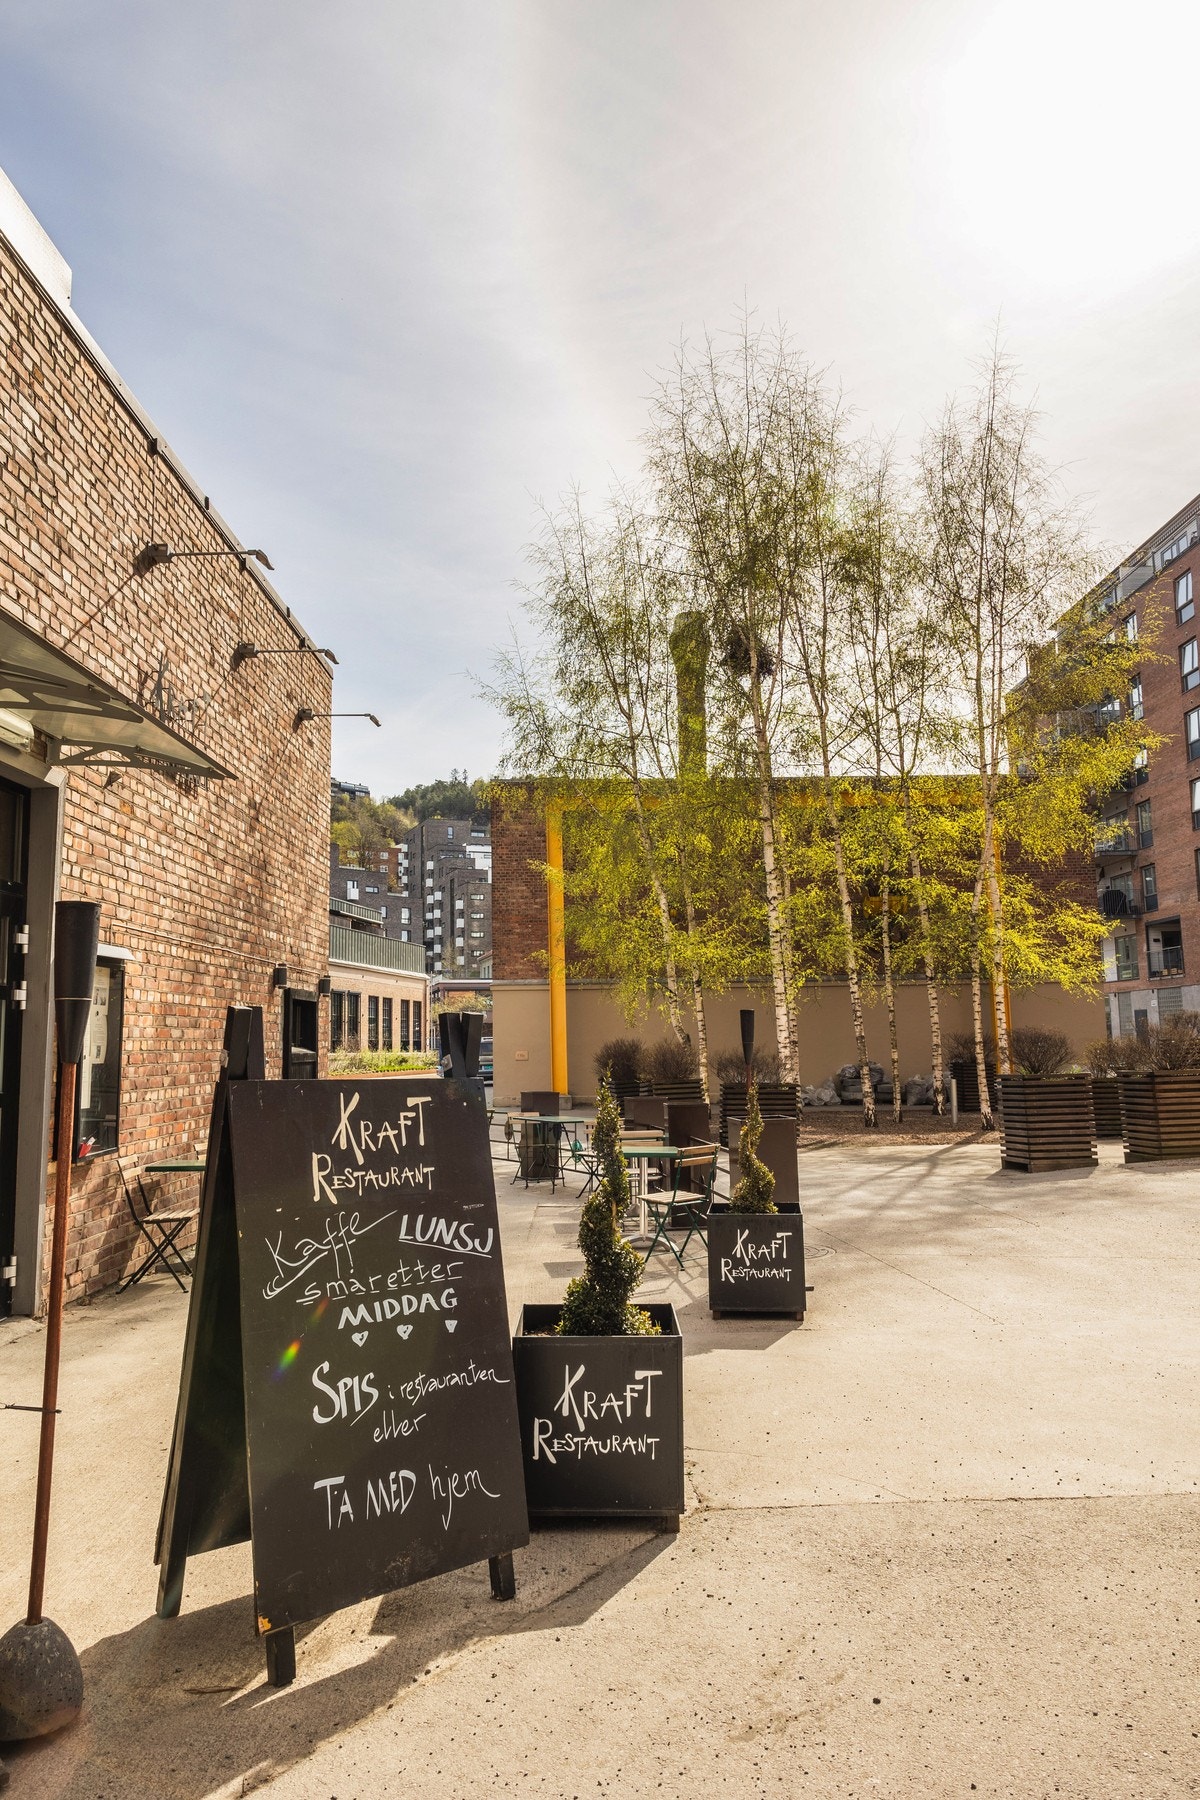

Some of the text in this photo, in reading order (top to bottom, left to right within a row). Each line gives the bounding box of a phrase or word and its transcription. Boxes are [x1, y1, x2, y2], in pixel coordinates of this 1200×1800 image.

[331, 1091, 432, 1165] KRAFT
[311, 1152, 435, 1204] RESTAURANT
[264, 1209, 494, 1279] Kaffe LUNSJ
[731, 1228, 793, 1266] KRAFT
[720, 1257, 793, 1284] RESTAURANT
[337, 1287, 458, 1330] MIDDAG
[311, 1359, 510, 1426] SPIS i restauranten
[553, 1364, 663, 1432] KRAFT
[373, 1409, 427, 1443] eller
[532, 1417, 661, 1464] RESTAURANT
[366, 1470, 417, 1520] MED
[428, 1463, 501, 1531] hjem
